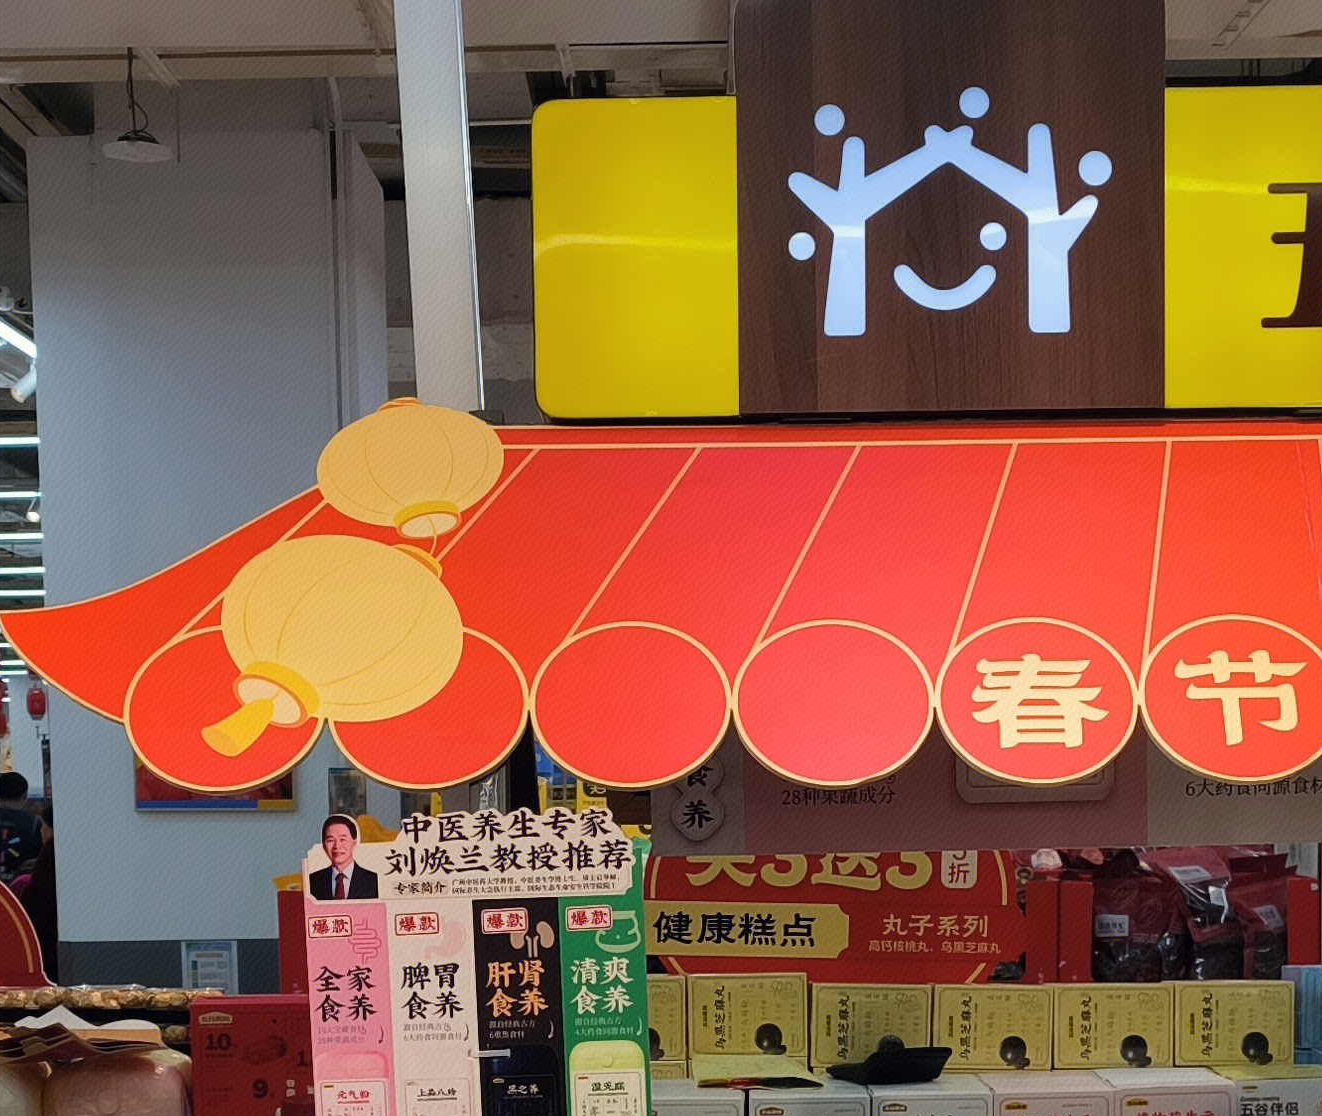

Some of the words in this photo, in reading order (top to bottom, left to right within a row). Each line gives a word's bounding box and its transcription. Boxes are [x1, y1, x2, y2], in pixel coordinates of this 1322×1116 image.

[402, 809, 612, 843] 中医养生专家
[384, 839, 632, 876] 刘焕兰教授推荐
[312, 917, 349, 935] 爆款
[399, 915, 435, 933] 爆款
[486, 911, 524, 930] 爆款
[570, 909, 609, 927] 爆款
[654, 912, 816, 947] 健康糕点
[882, 914, 989, 938] 丸子系列
[313, 965, 376, 992] 全家
[400, 962, 459, 990] 脾胃
[485, 960, 545, 988] 肝肾
[570, 957, 634, 986] 清爽
[315, 994, 378, 1022] 食养
[401, 992, 464, 1019] 食养
[486, 988, 549, 1018] 食养
[572, 985, 634, 1015] 食养
[1240, 1102, 1298, 1116] 五谷伴侣
